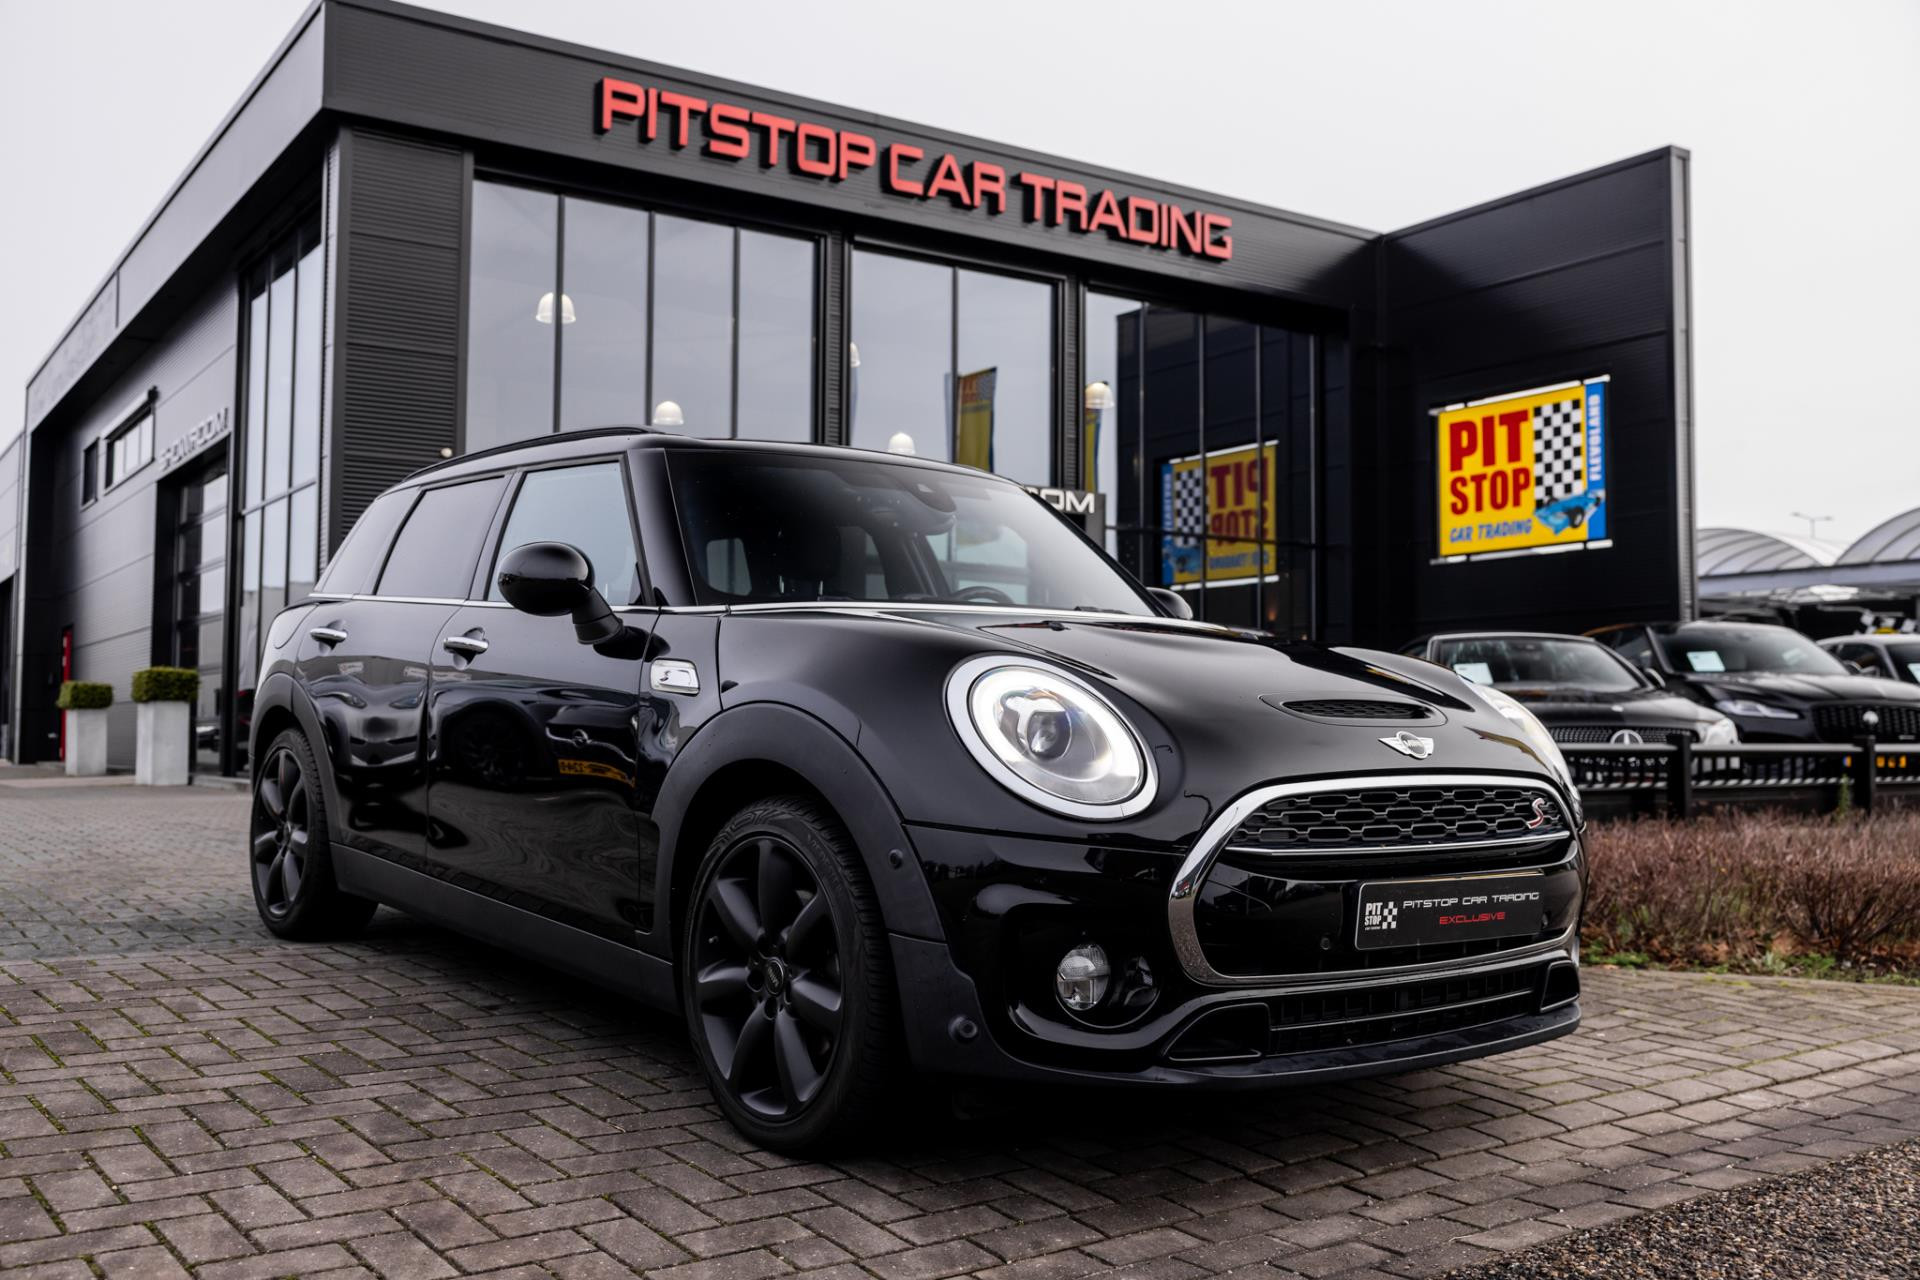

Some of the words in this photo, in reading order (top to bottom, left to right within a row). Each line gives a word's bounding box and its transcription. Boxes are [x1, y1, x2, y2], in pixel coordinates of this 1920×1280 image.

[600, 77, 877, 180] PITSTOP
[888, 143, 1007, 213] CAR
[1019, 172, 1233, 260] TRADING
[1450, 409, 1529, 472] PIT
[1450, 467, 1531, 516] STOP
[1450, 526, 1474, 543] CAR
[1478, 518, 1533, 540] TRADING
[1526, 798, 1546, 829] S
[1365, 902, 1384, 916] PIT
[1402, 897, 1459, 909] PITSTOP
[1462, 895, 1488, 905] CAR
[1492, 892, 1540, 903] TRADING
[1364, 915, 1382, 926] STOP
[1439, 911, 1506, 925] EXCLUSIVE
